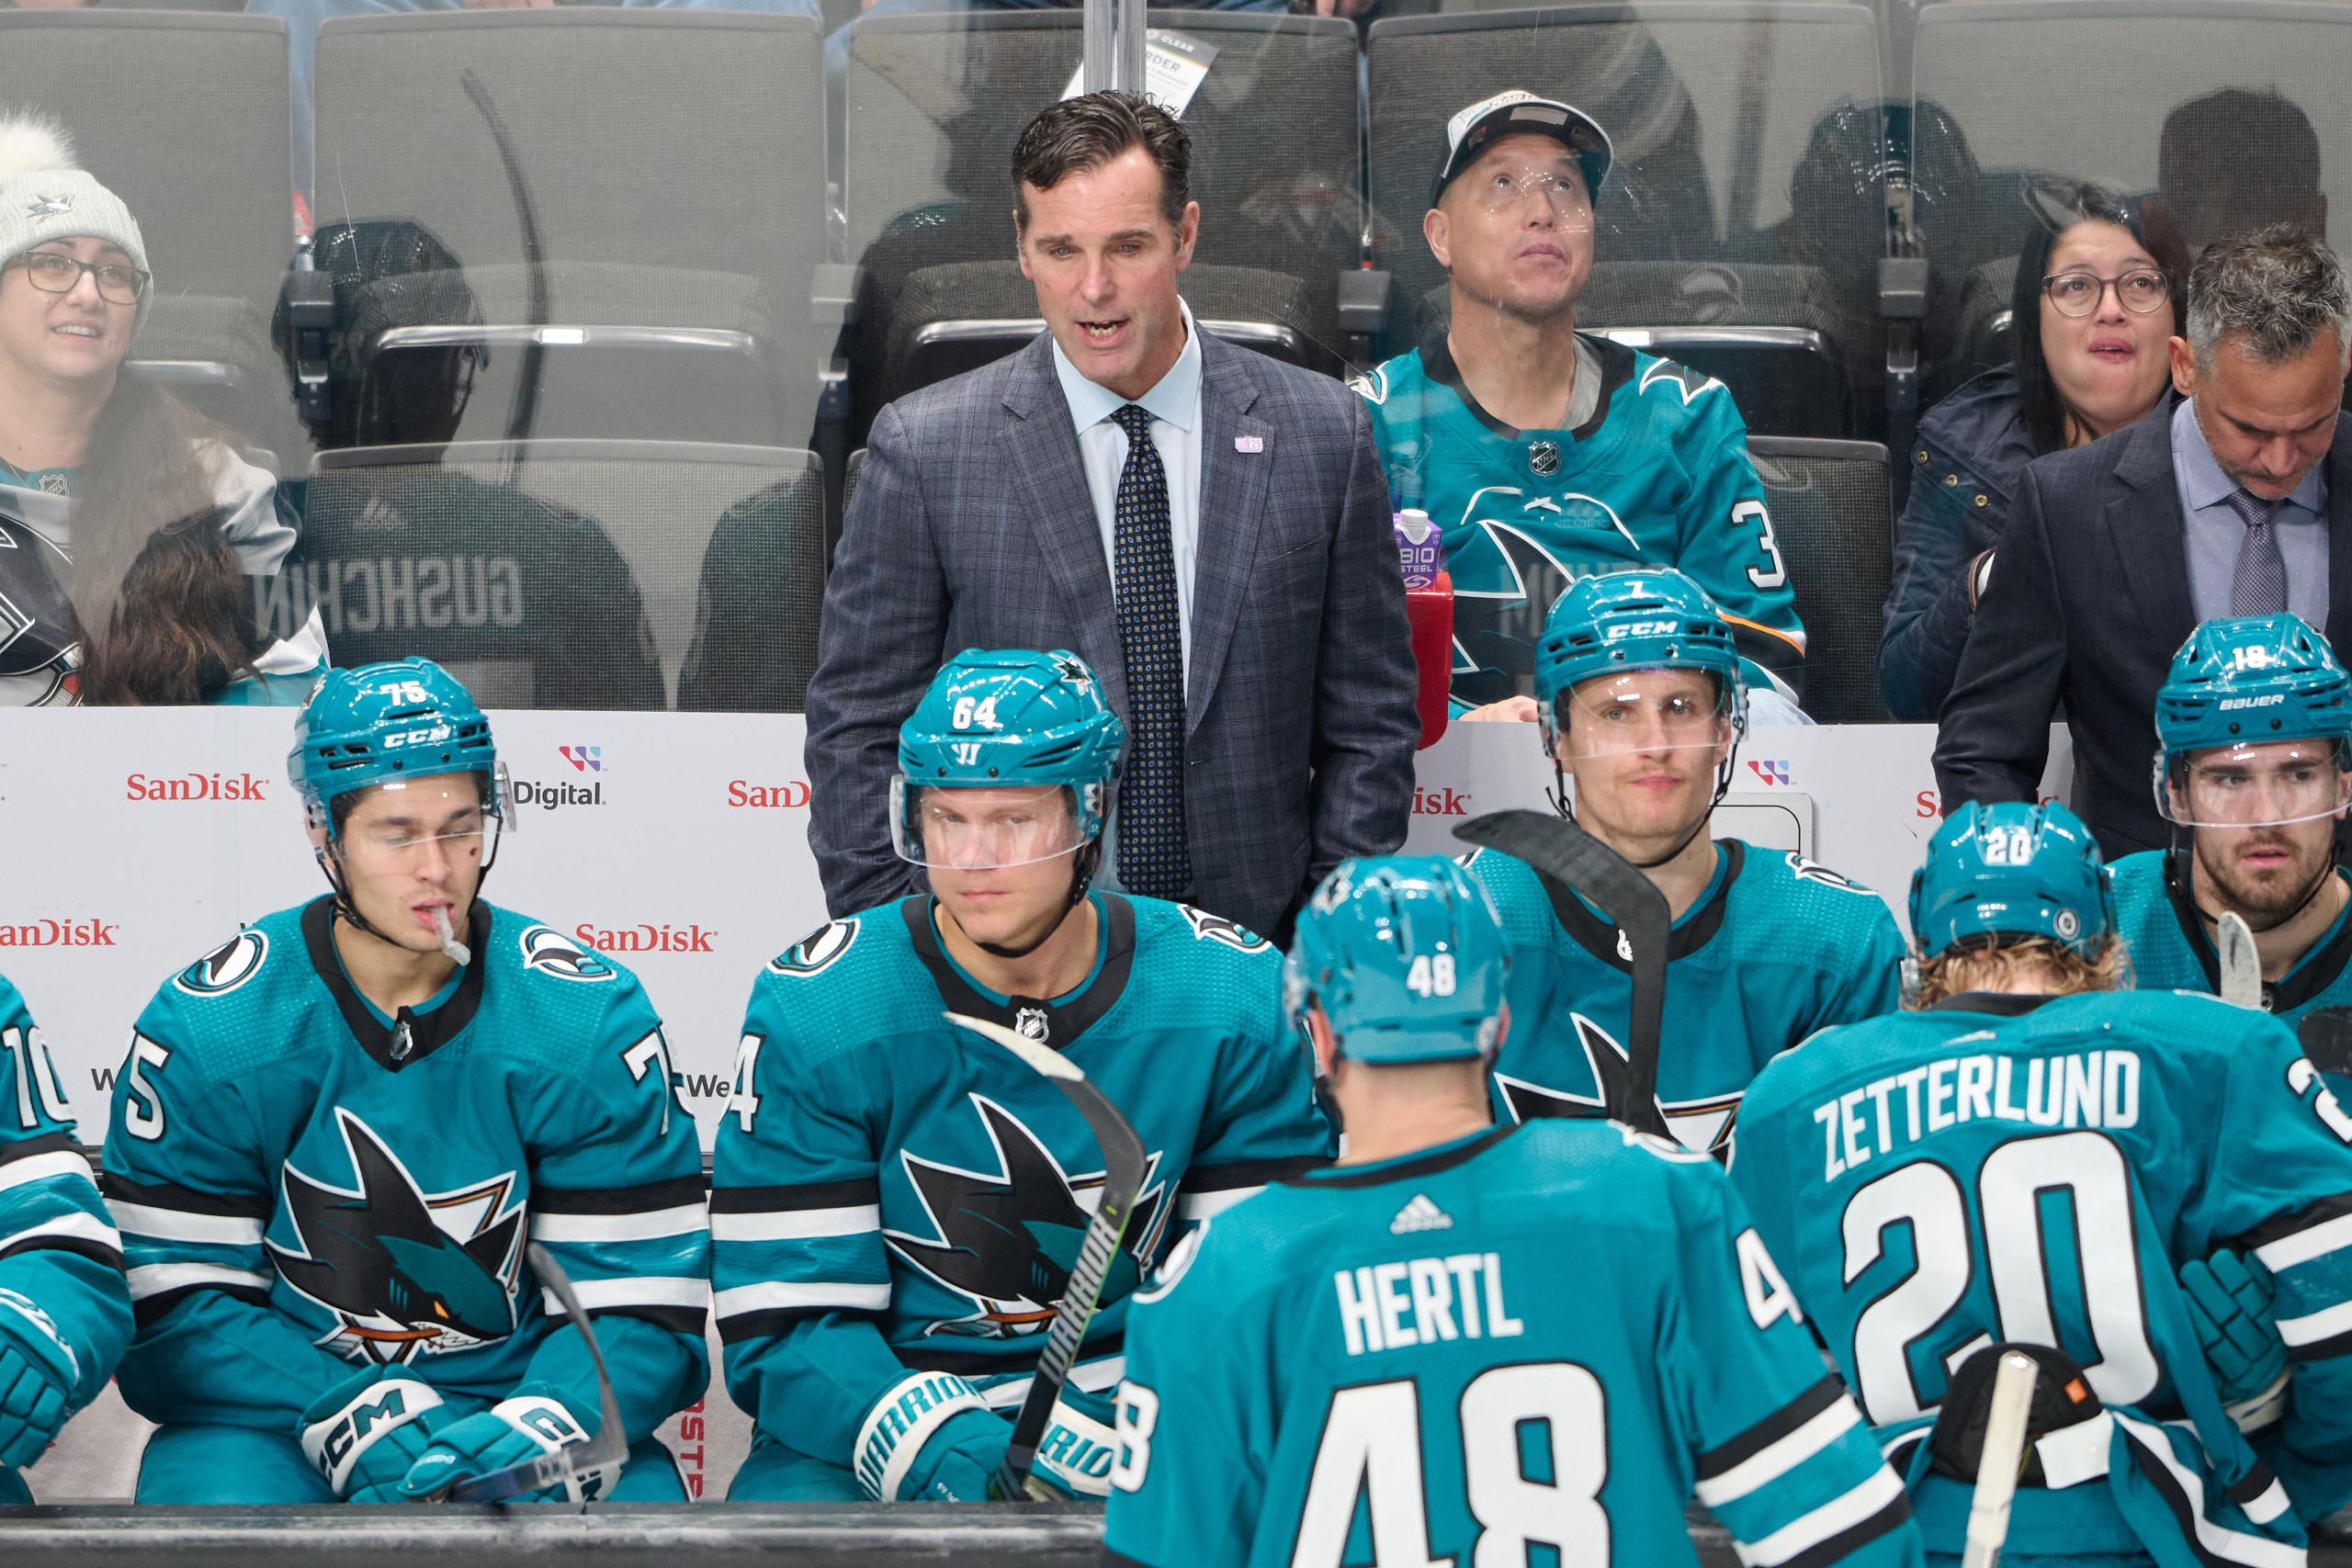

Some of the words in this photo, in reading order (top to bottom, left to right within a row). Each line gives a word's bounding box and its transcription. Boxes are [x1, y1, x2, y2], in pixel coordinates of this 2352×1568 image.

[1160, 37, 1194, 54] CLEAR
[1399, 547, 1435, 564] BIO
[1731, 500, 1785, 589] 3
[1400, 565, 1433, 573] STEEL
[1607, 620, 1678, 638] CCM
[379, 680, 427, 706] 75
[2219, 694, 2285, 711] BAUER
[952, 696, 997, 730] 64
[383, 724, 451, 749] CCM
[127, 773, 266, 801] SanDisk
[514, 781, 602, 811] Digital
[576, 923, 715, 952] SanDisk
[1406, 953, 1457, 998] 48
[1813, 1050, 2141, 1184] ZETTERLUND
[1841, 1130, 2160, 1427] 20
[1334, 1251, 1525, 1357] HERTL
[1286, 1362, 1610, 1568] 48
